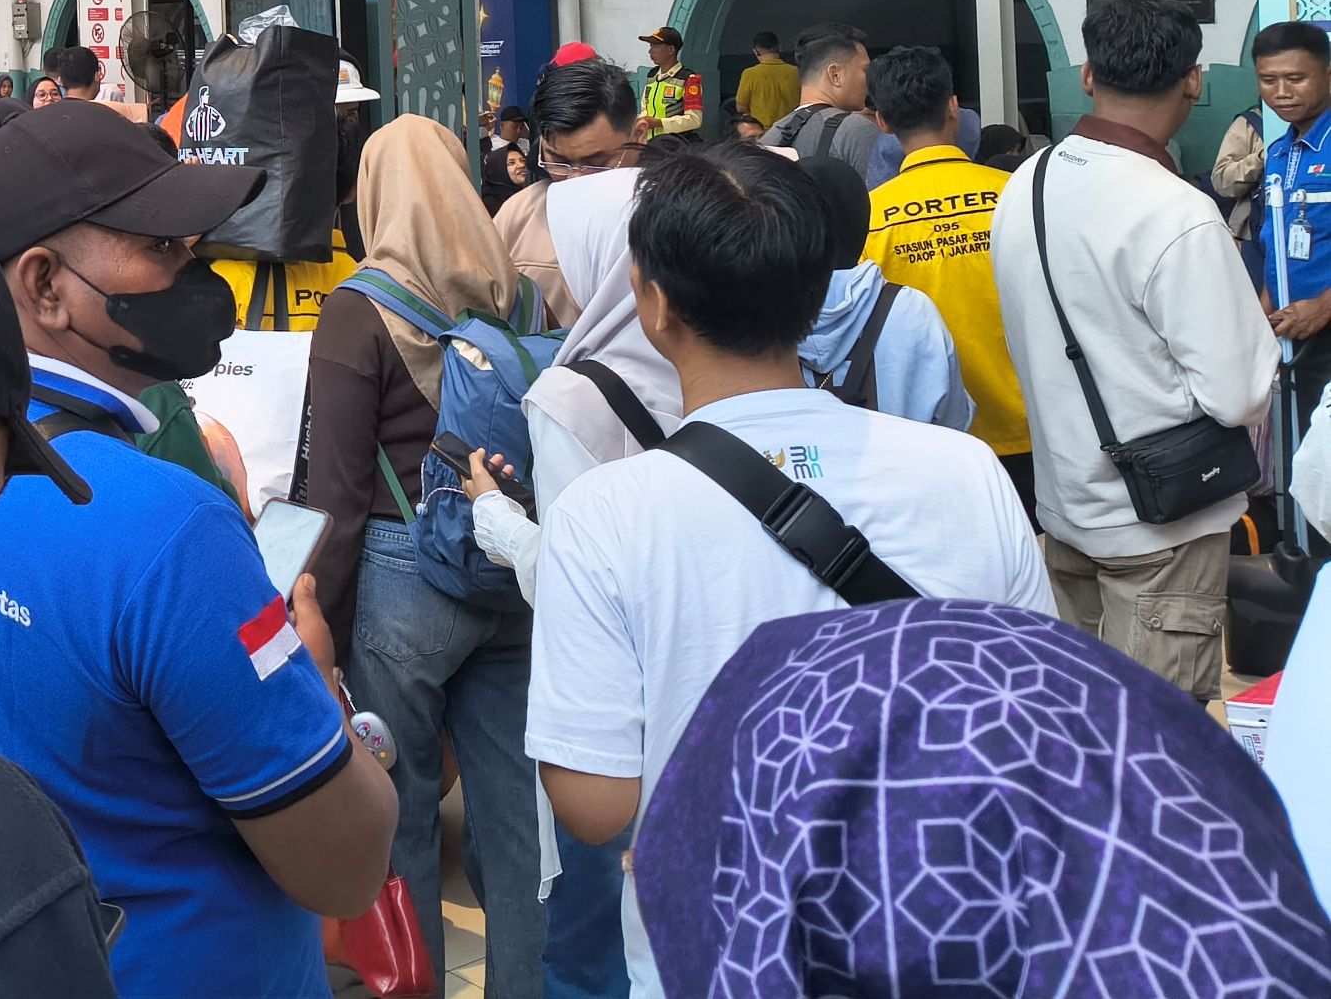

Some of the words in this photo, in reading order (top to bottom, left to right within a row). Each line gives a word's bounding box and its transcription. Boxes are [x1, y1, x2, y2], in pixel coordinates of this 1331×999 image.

[195, 147, 249, 165] HEART
[883, 191, 999, 222] PORTER
[933, 222, 960, 233] 095
[894, 240, 933, 255] STASIUN
[936, 234, 968, 247] PASAR
[909, 250, 936, 263] DAOP
[949, 242, 991, 257] JAKARTA
